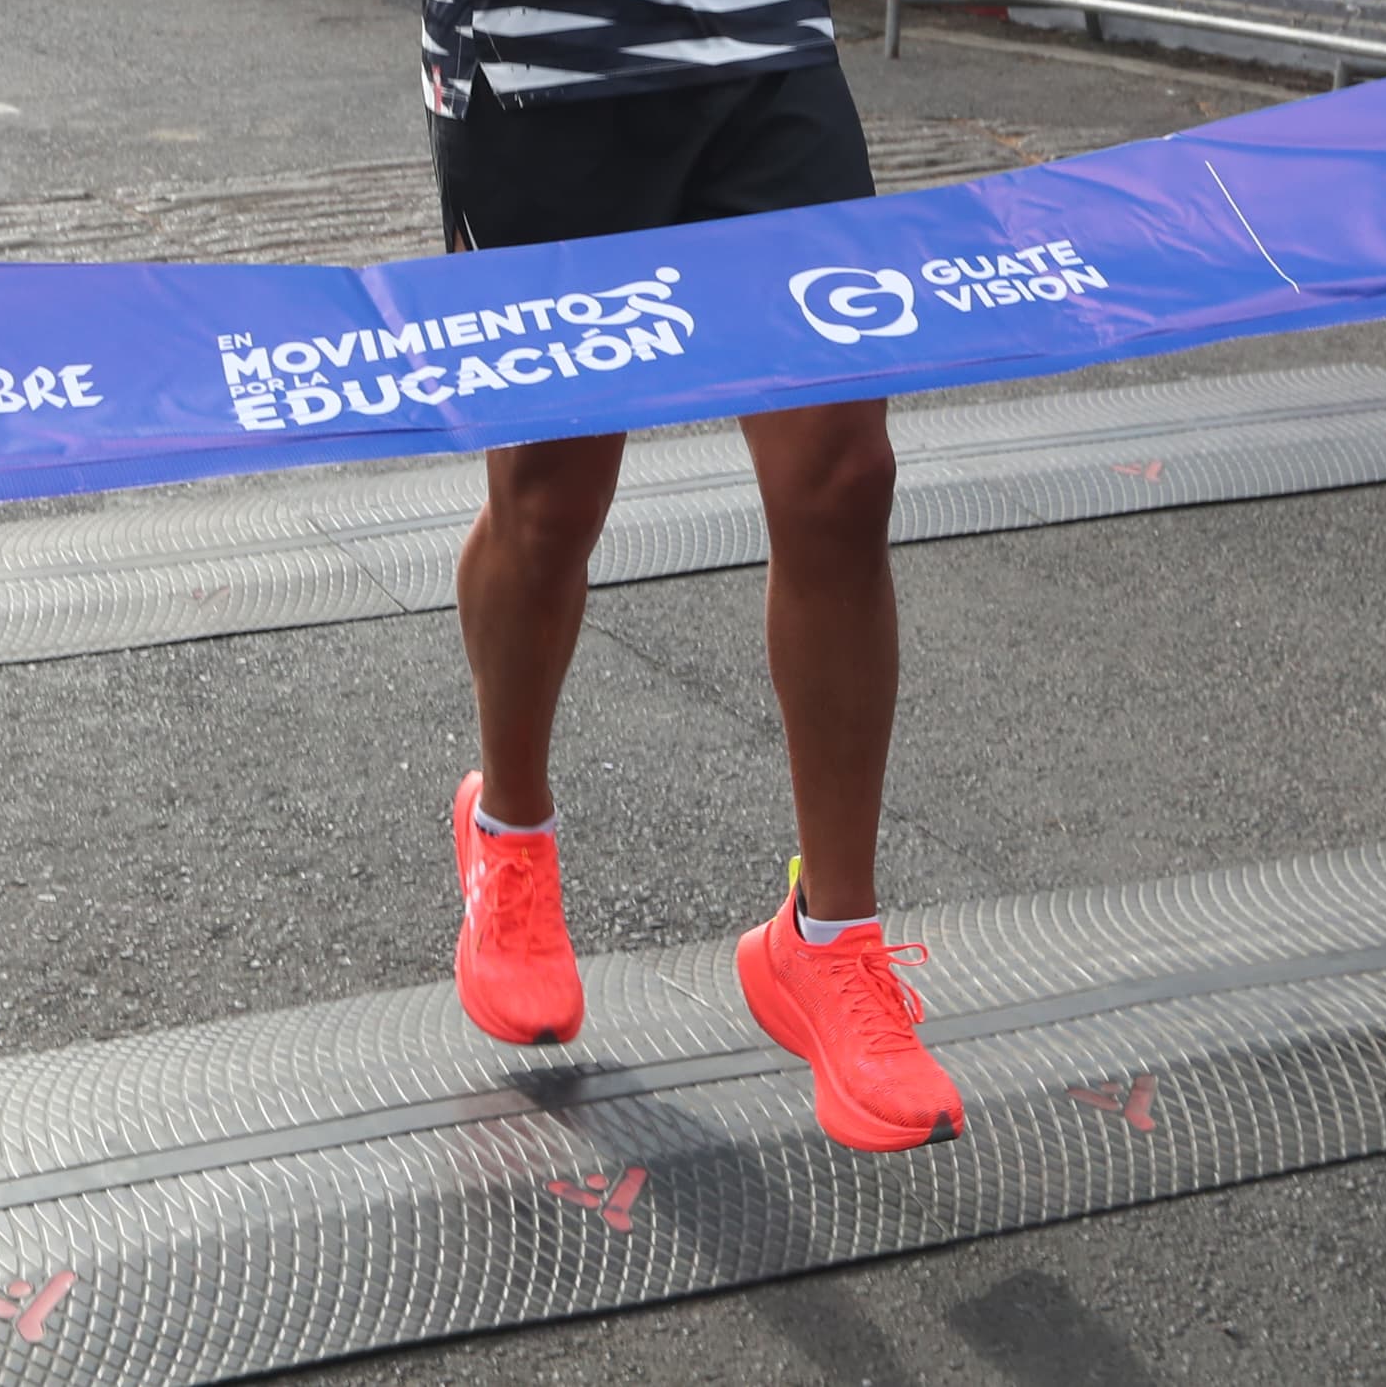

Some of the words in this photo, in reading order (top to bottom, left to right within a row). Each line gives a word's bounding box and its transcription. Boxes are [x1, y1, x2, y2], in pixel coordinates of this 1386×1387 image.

[921, 238, 1084, 286] GUATE
[934, 264, 1109, 313] VISION
[218, 332, 252, 351] EN
[221, 293, 613, 385] MOVIMIENTO
[230, 378, 285, 399] POR
[295, 372, 330, 390] LA
[232, 321, 684, 432] EDUCACIÓN
